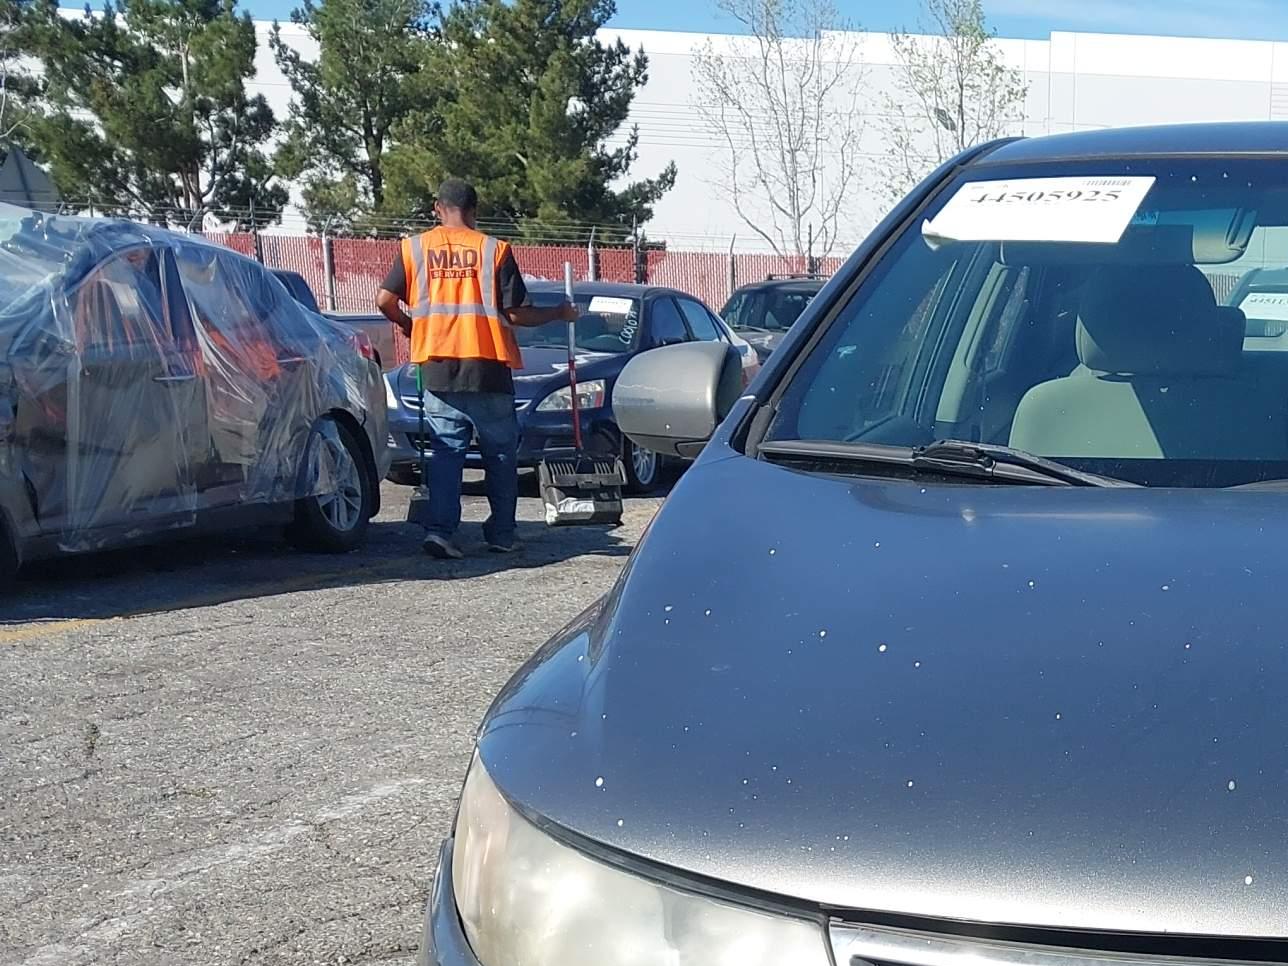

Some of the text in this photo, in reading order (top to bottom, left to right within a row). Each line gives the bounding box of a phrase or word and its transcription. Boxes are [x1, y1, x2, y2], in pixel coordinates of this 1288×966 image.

[970, 190, 1121, 204] 44505925
[427, 249, 478, 268] MAD
[432, 270, 476, 279] SERVICES
